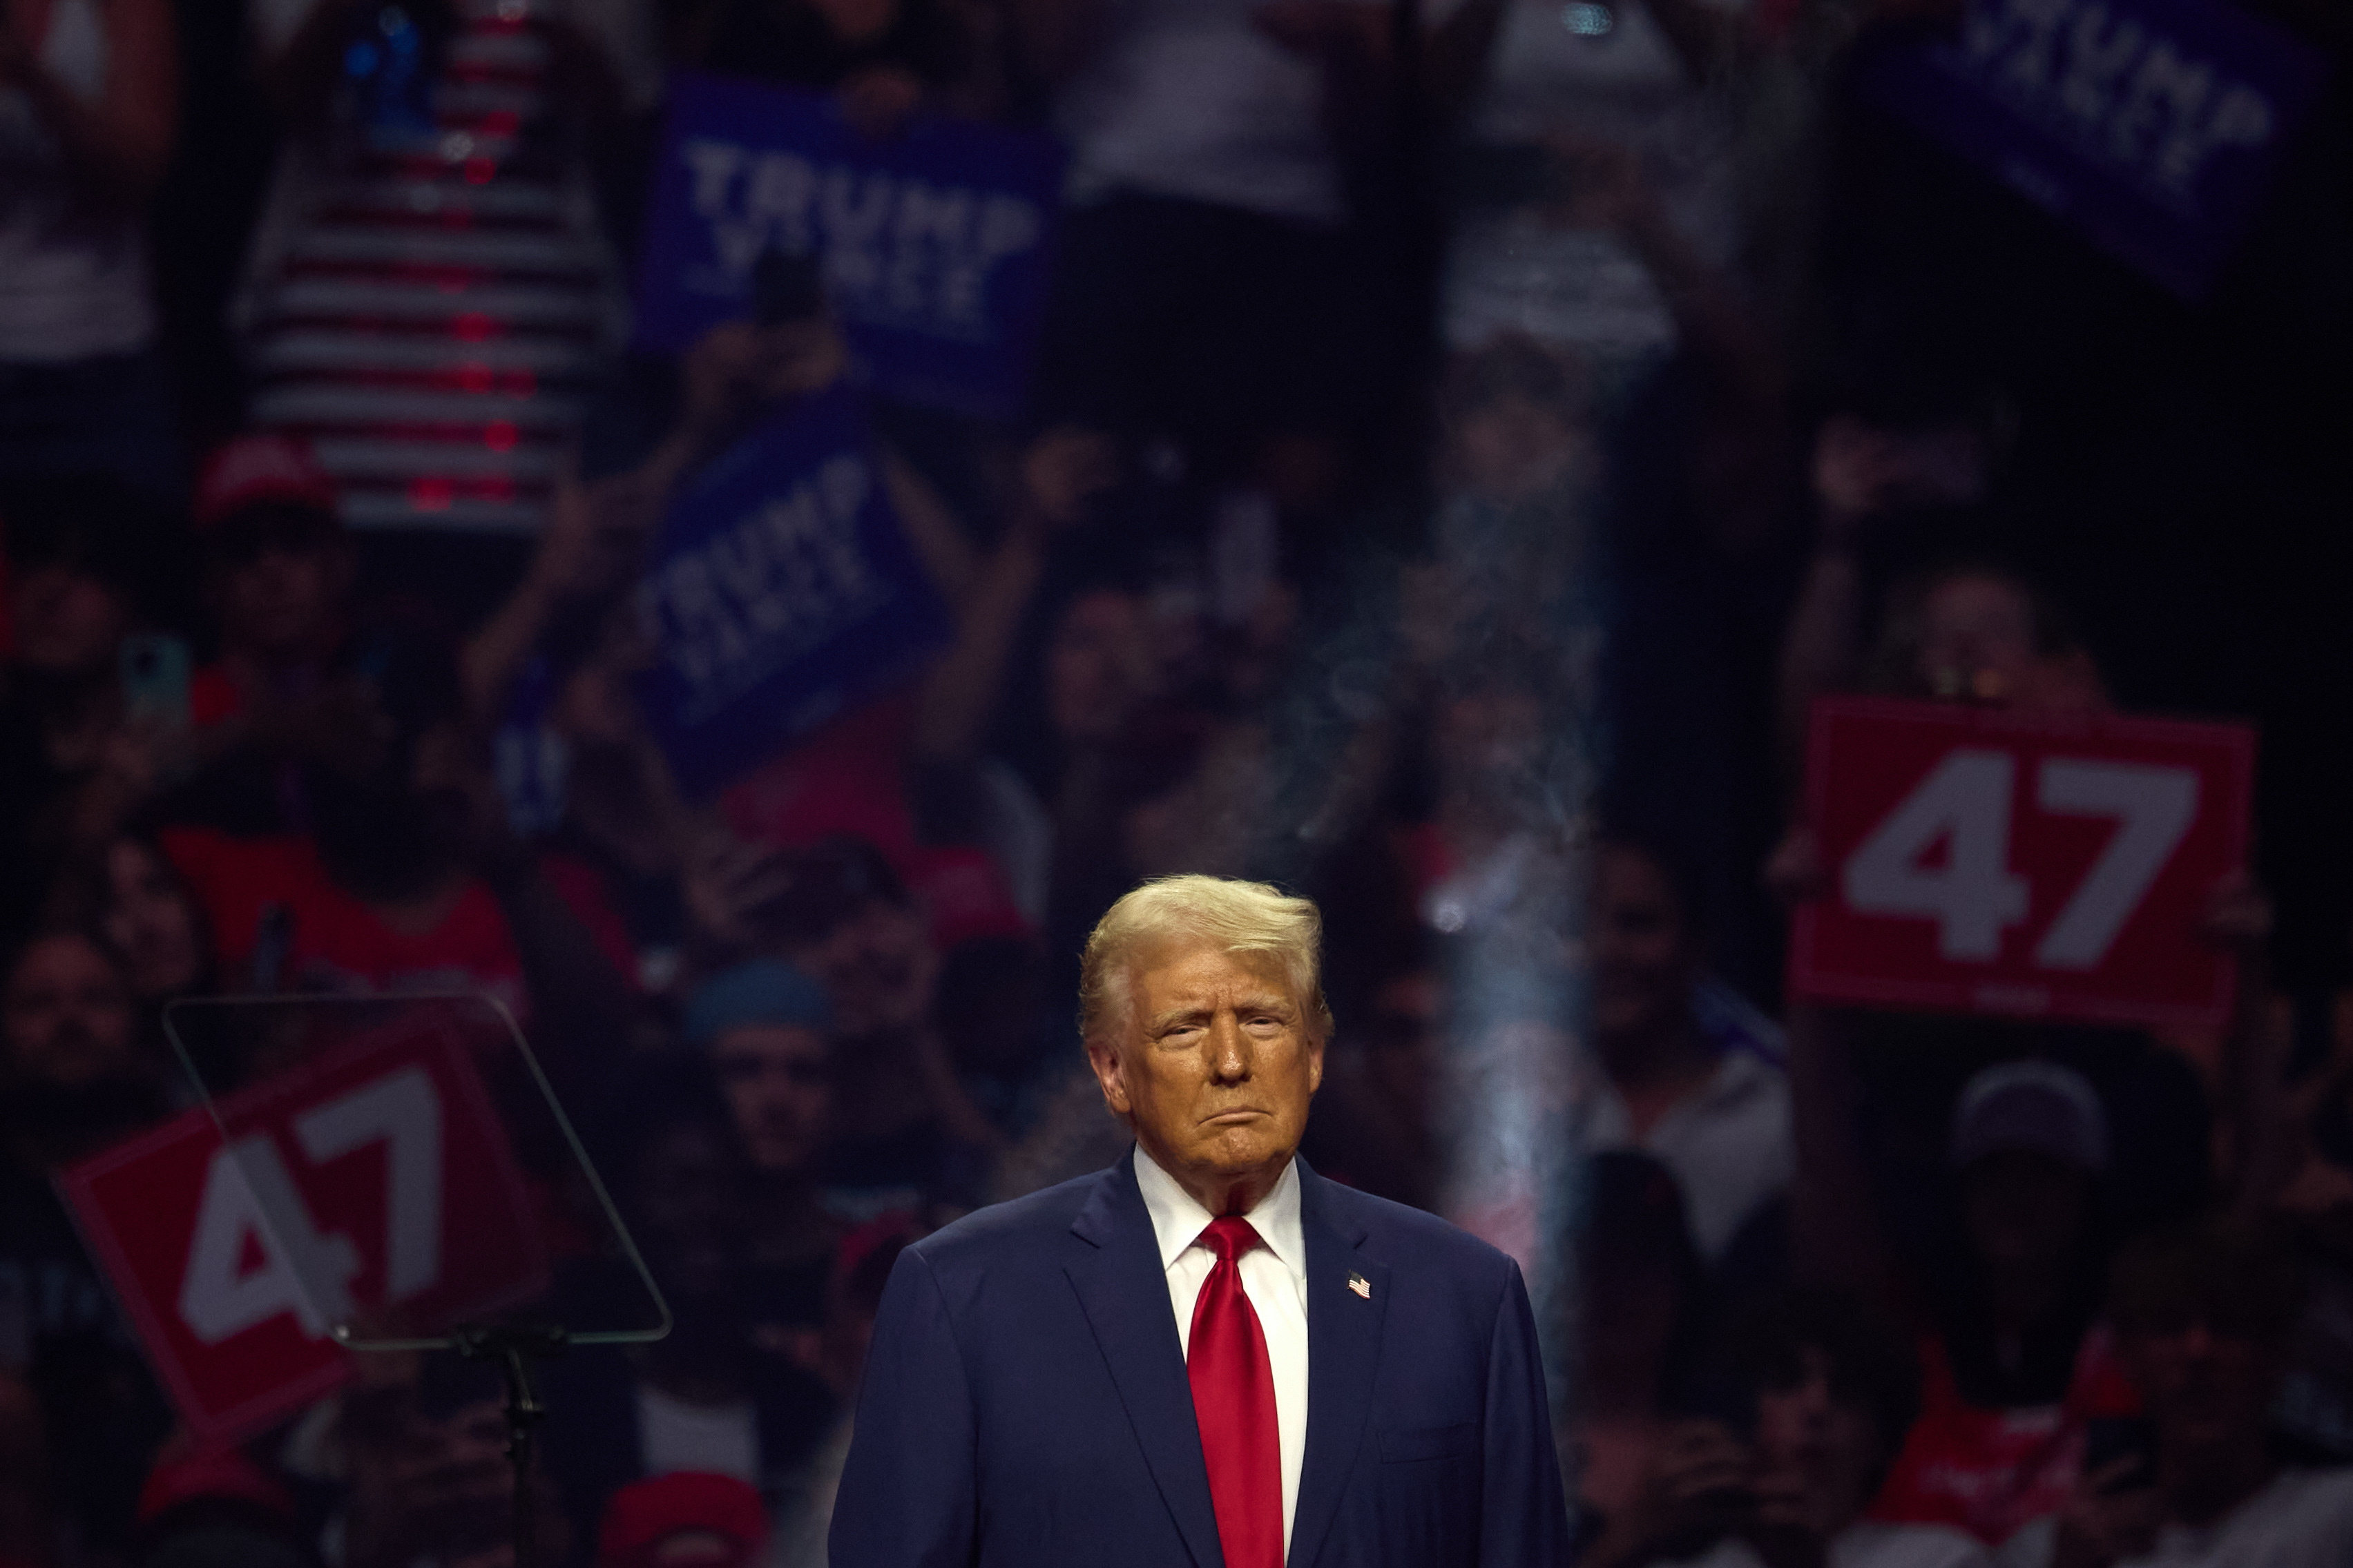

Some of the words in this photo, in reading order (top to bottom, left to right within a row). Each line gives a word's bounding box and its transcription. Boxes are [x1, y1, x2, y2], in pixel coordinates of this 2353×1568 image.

[677, 133, 1043, 264] TRUMP
[709, 218, 995, 323] VNCE
[1839, 744, 2203, 972] 47
[175, 1061, 445, 1346] 47
